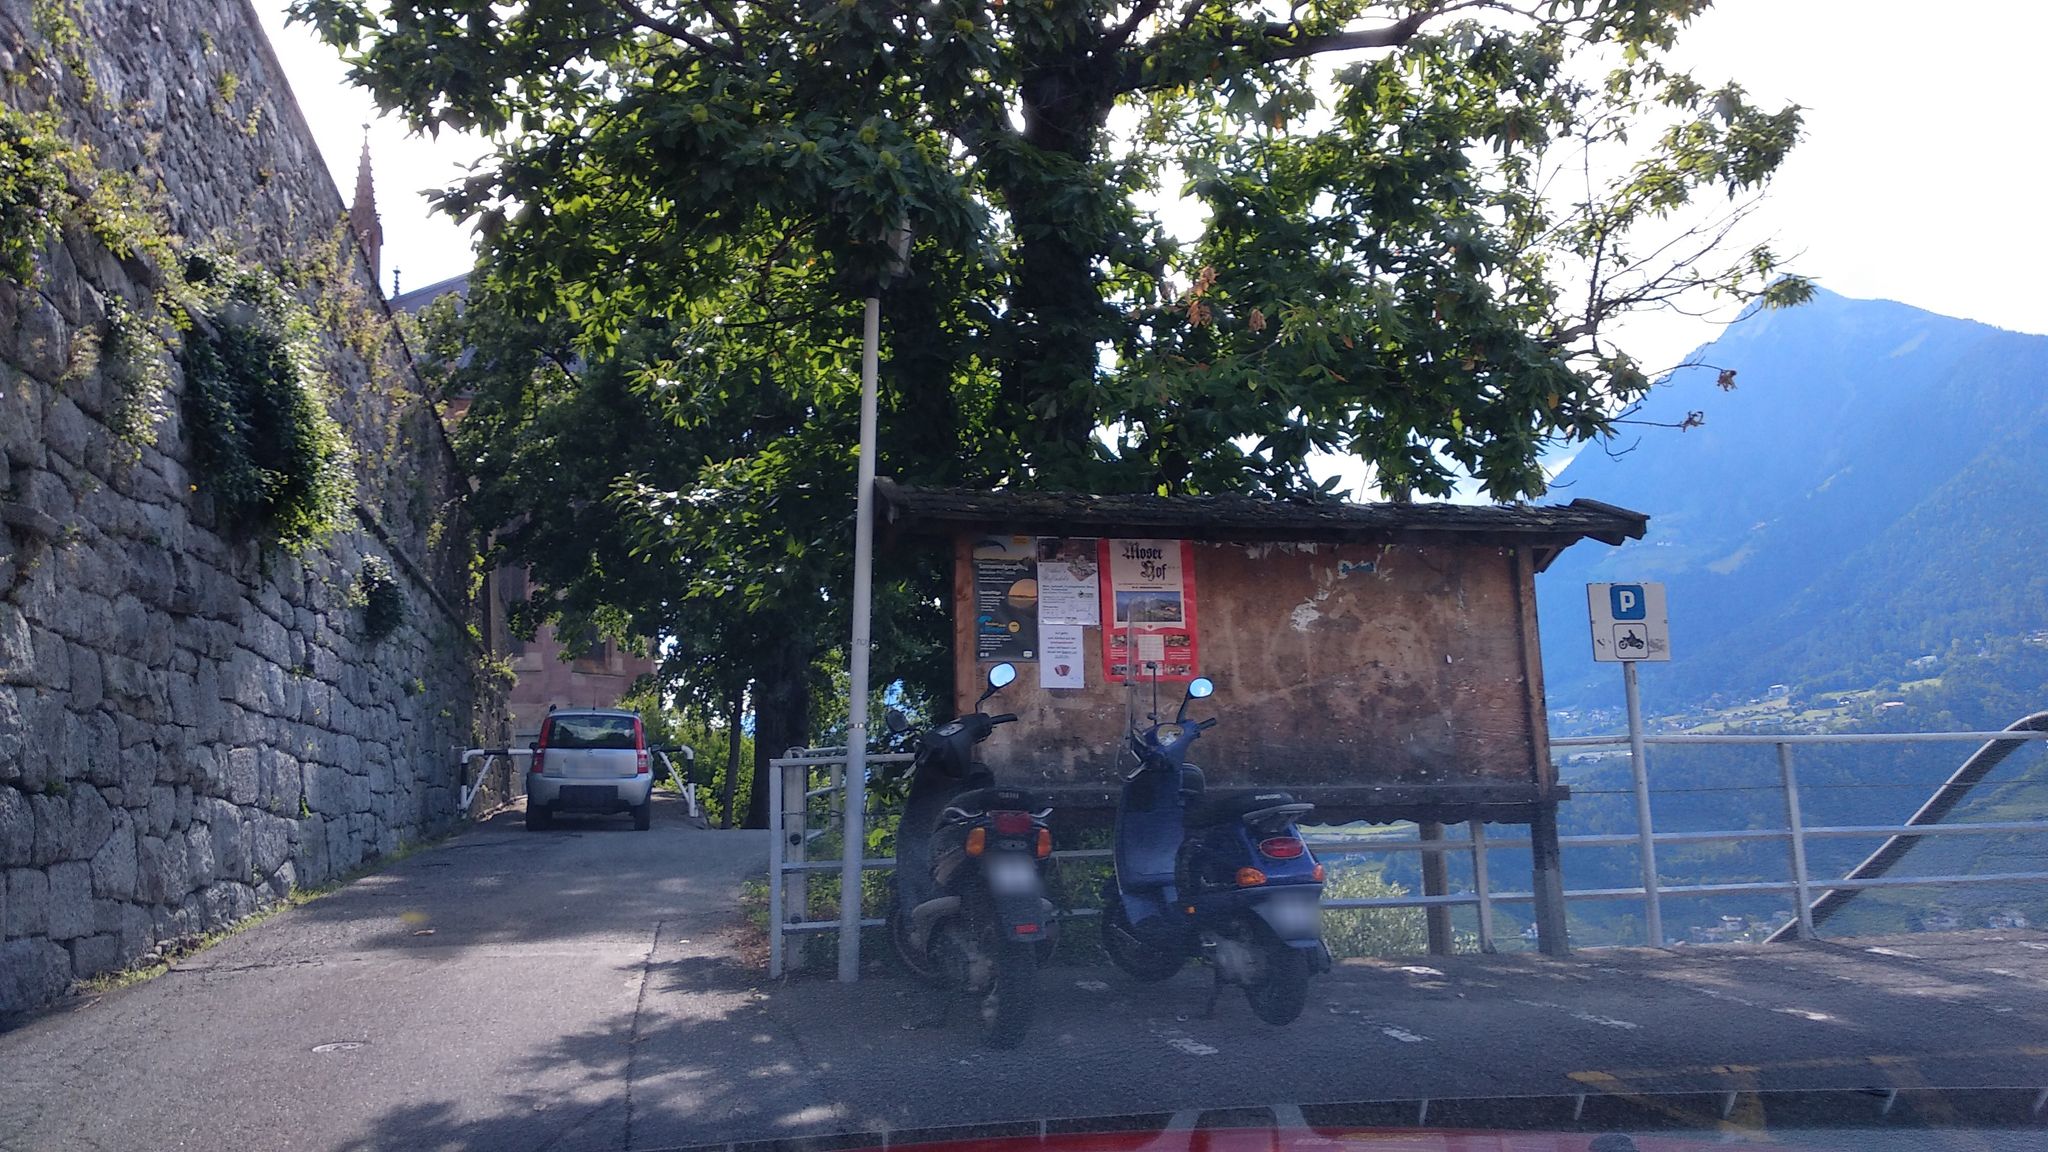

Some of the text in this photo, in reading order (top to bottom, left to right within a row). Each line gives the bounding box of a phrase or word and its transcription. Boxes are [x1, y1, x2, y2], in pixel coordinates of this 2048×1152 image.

[1121, 541, 1163, 560] Moser
[1140, 560, 1168, 581] Hof
[1619, 590, 1635, 612] P
